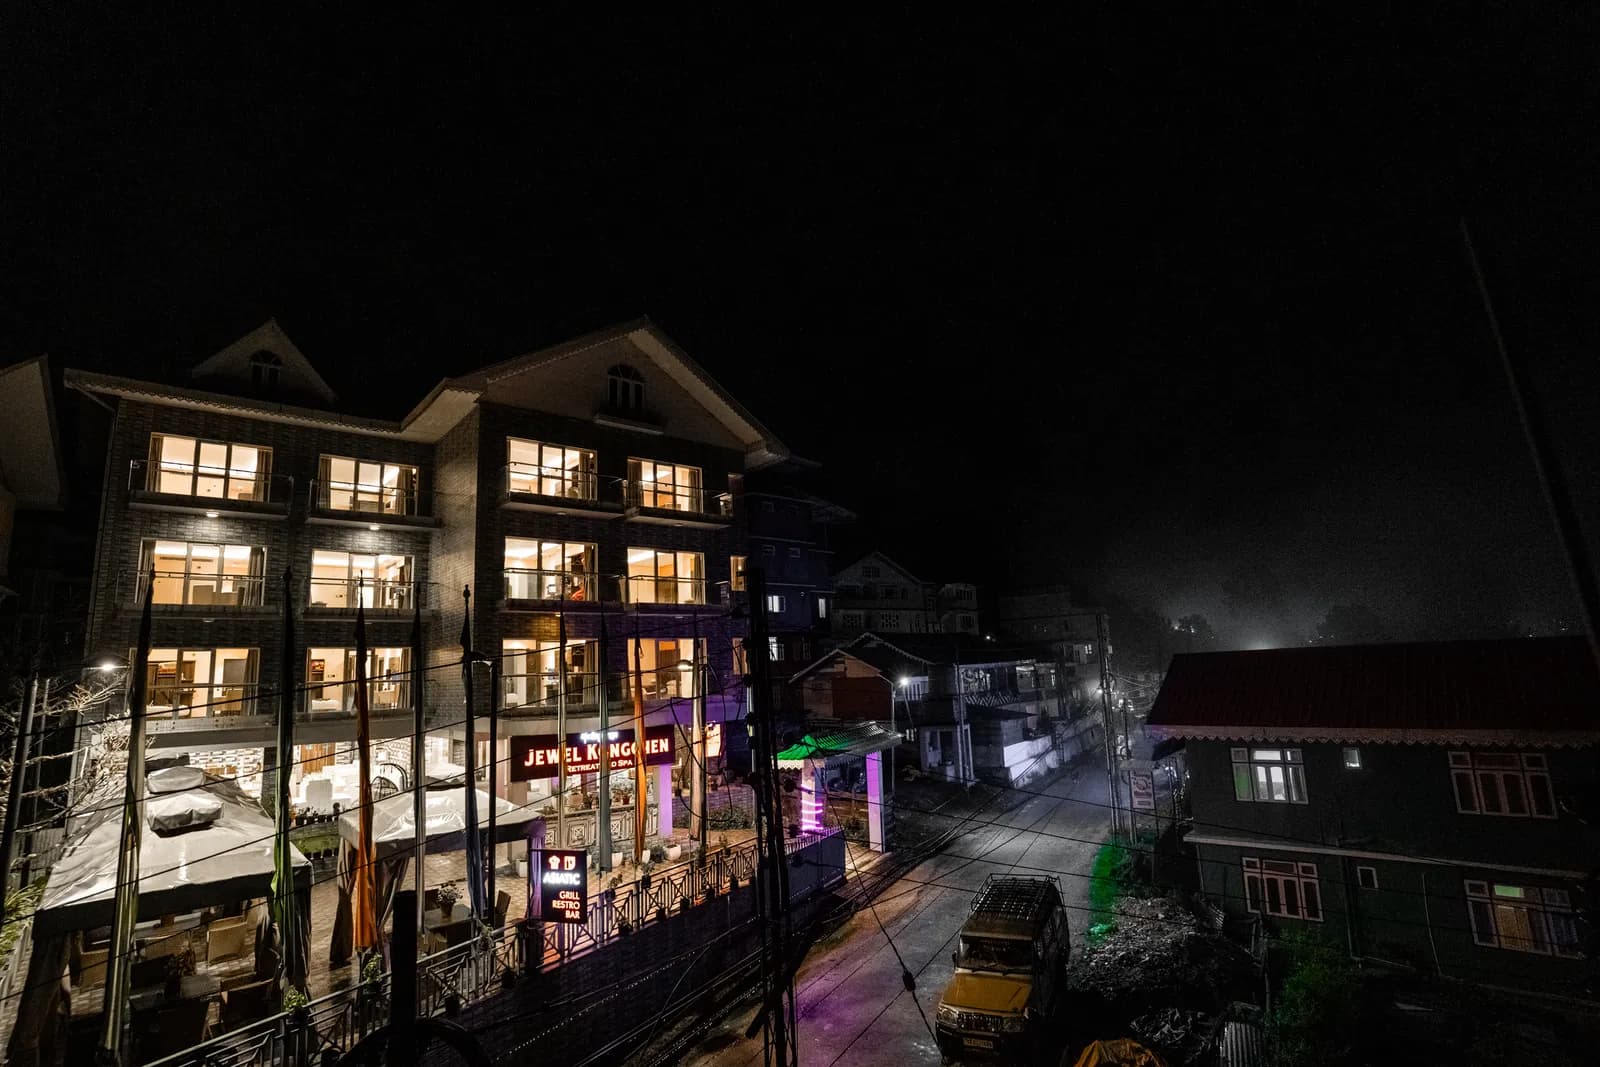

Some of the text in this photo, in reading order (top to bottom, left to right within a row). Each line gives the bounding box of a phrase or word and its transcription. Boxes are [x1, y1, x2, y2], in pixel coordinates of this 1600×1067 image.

[524, 738, 669, 766] JEWEL KNGEN
[567, 763, 601, 773] RETREAT
[617, 759, 633, 767] SPA
[543, 871, 580, 885] ASIATIC
[559, 890, 580, 900] GRILL
[552, 899, 580, 910] RESTRO
[565, 910, 580, 919] BAR
